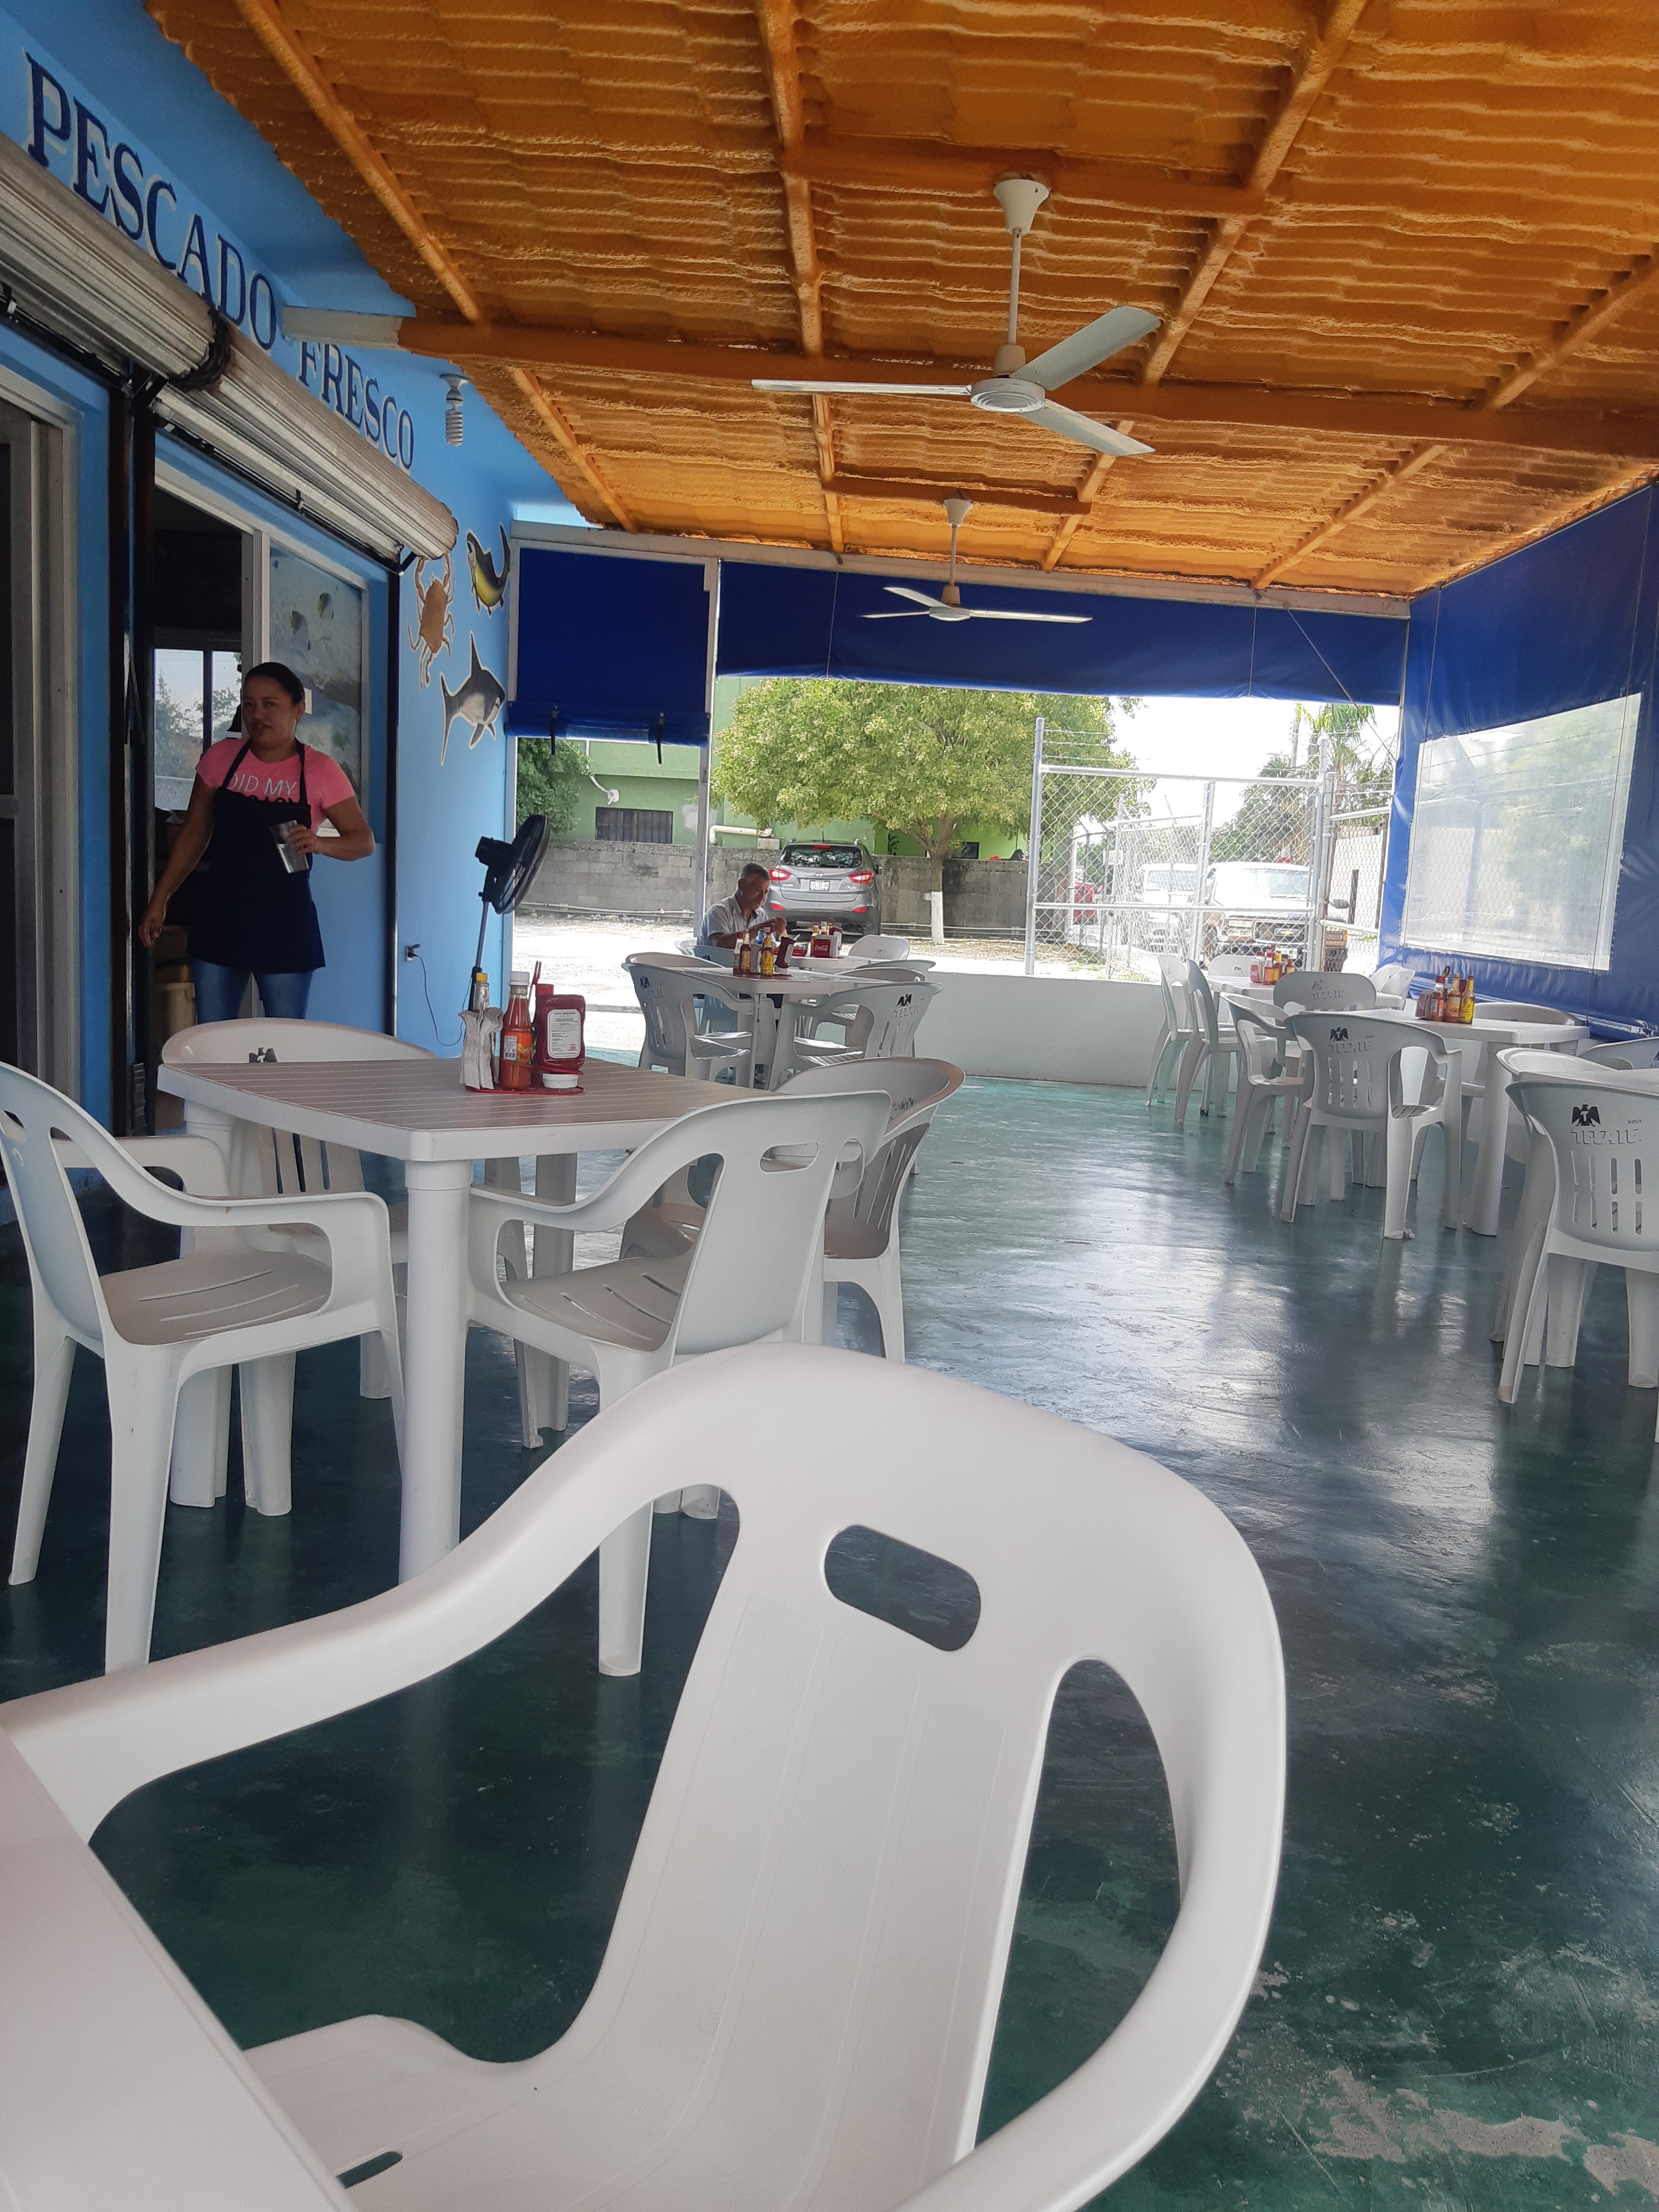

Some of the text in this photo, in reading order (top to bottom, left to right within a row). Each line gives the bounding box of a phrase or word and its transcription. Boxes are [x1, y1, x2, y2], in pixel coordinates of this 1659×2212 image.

[25, 52, 414, 470] PESCADO FRESCO
[264, 778, 297, 796] MY
